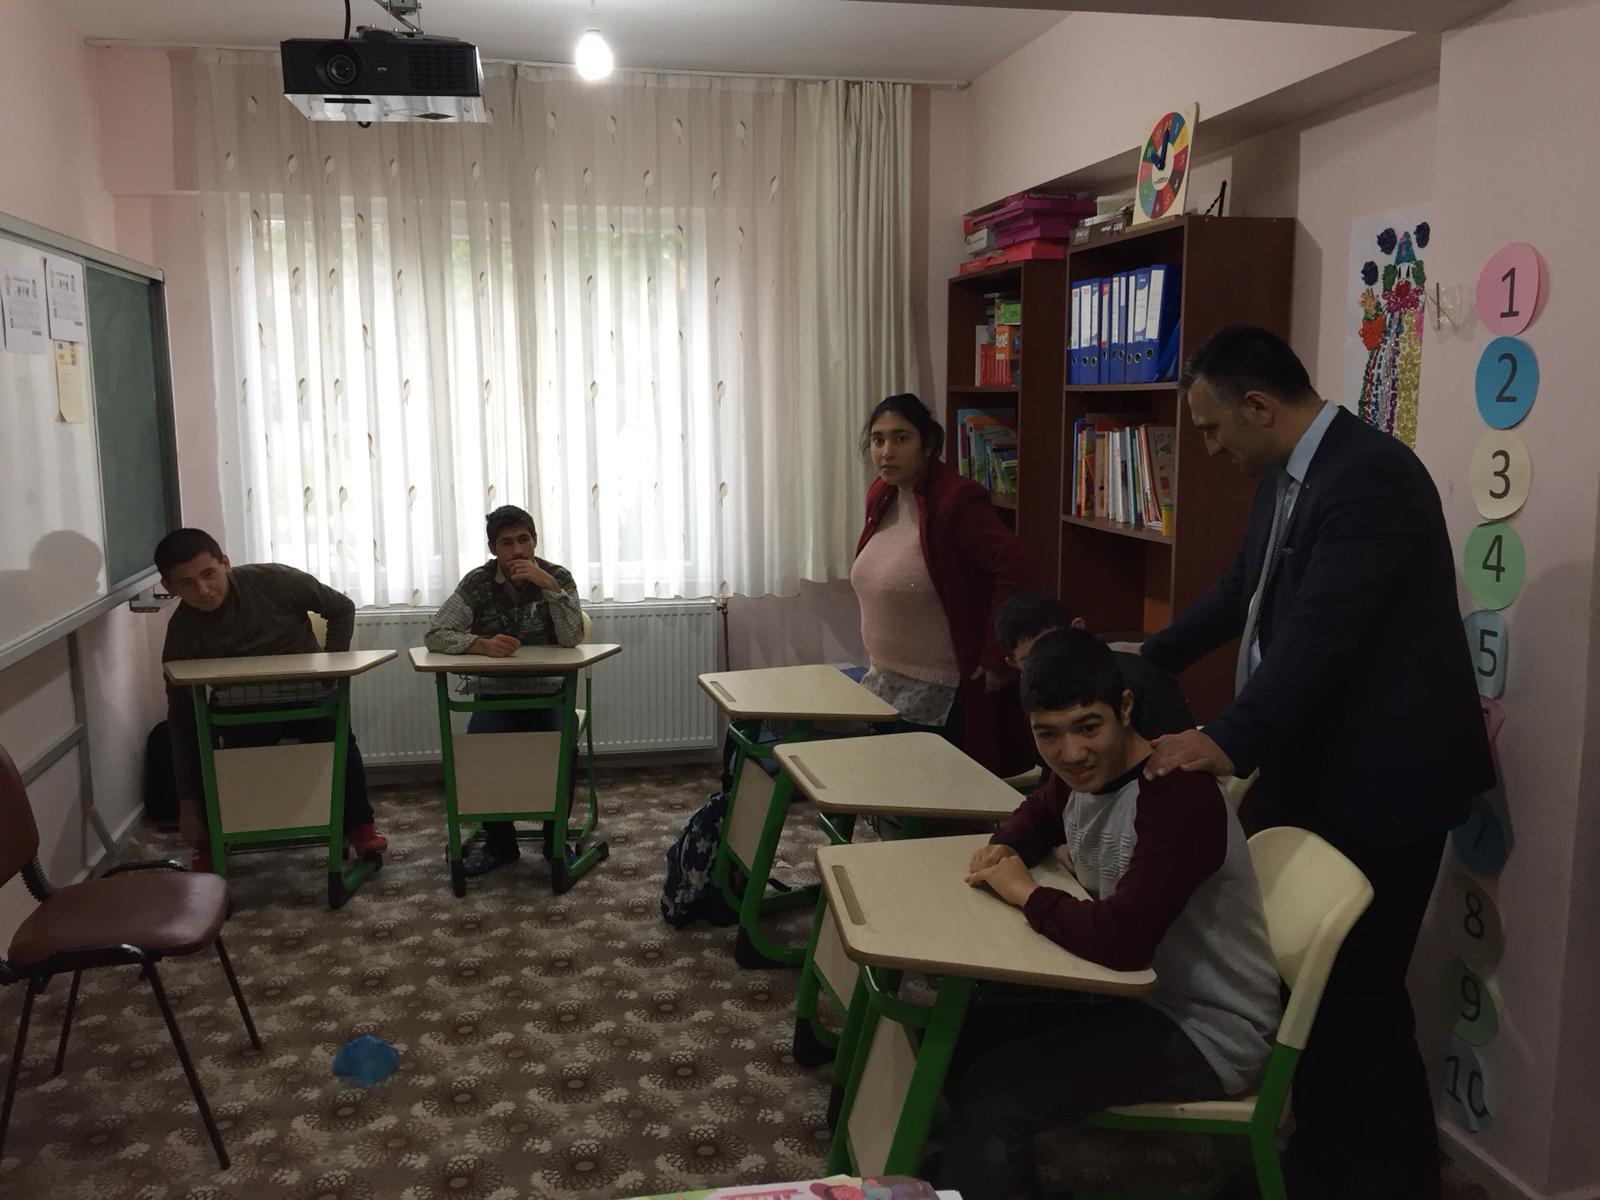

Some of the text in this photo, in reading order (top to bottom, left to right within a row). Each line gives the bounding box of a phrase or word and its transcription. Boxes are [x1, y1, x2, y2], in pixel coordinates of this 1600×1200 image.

[1499, 266, 1520, 319] 1
[1495, 352, 1518, 403] 2
[1489, 449, 1511, 500] 3
[1482, 534, 1506, 583] 4
[1477, 628, 1499, 678] 5
[1463, 890, 1485, 940] 8
[1460, 975, 1481, 1023] 9
[1445, 1055, 1490, 1118] 10
